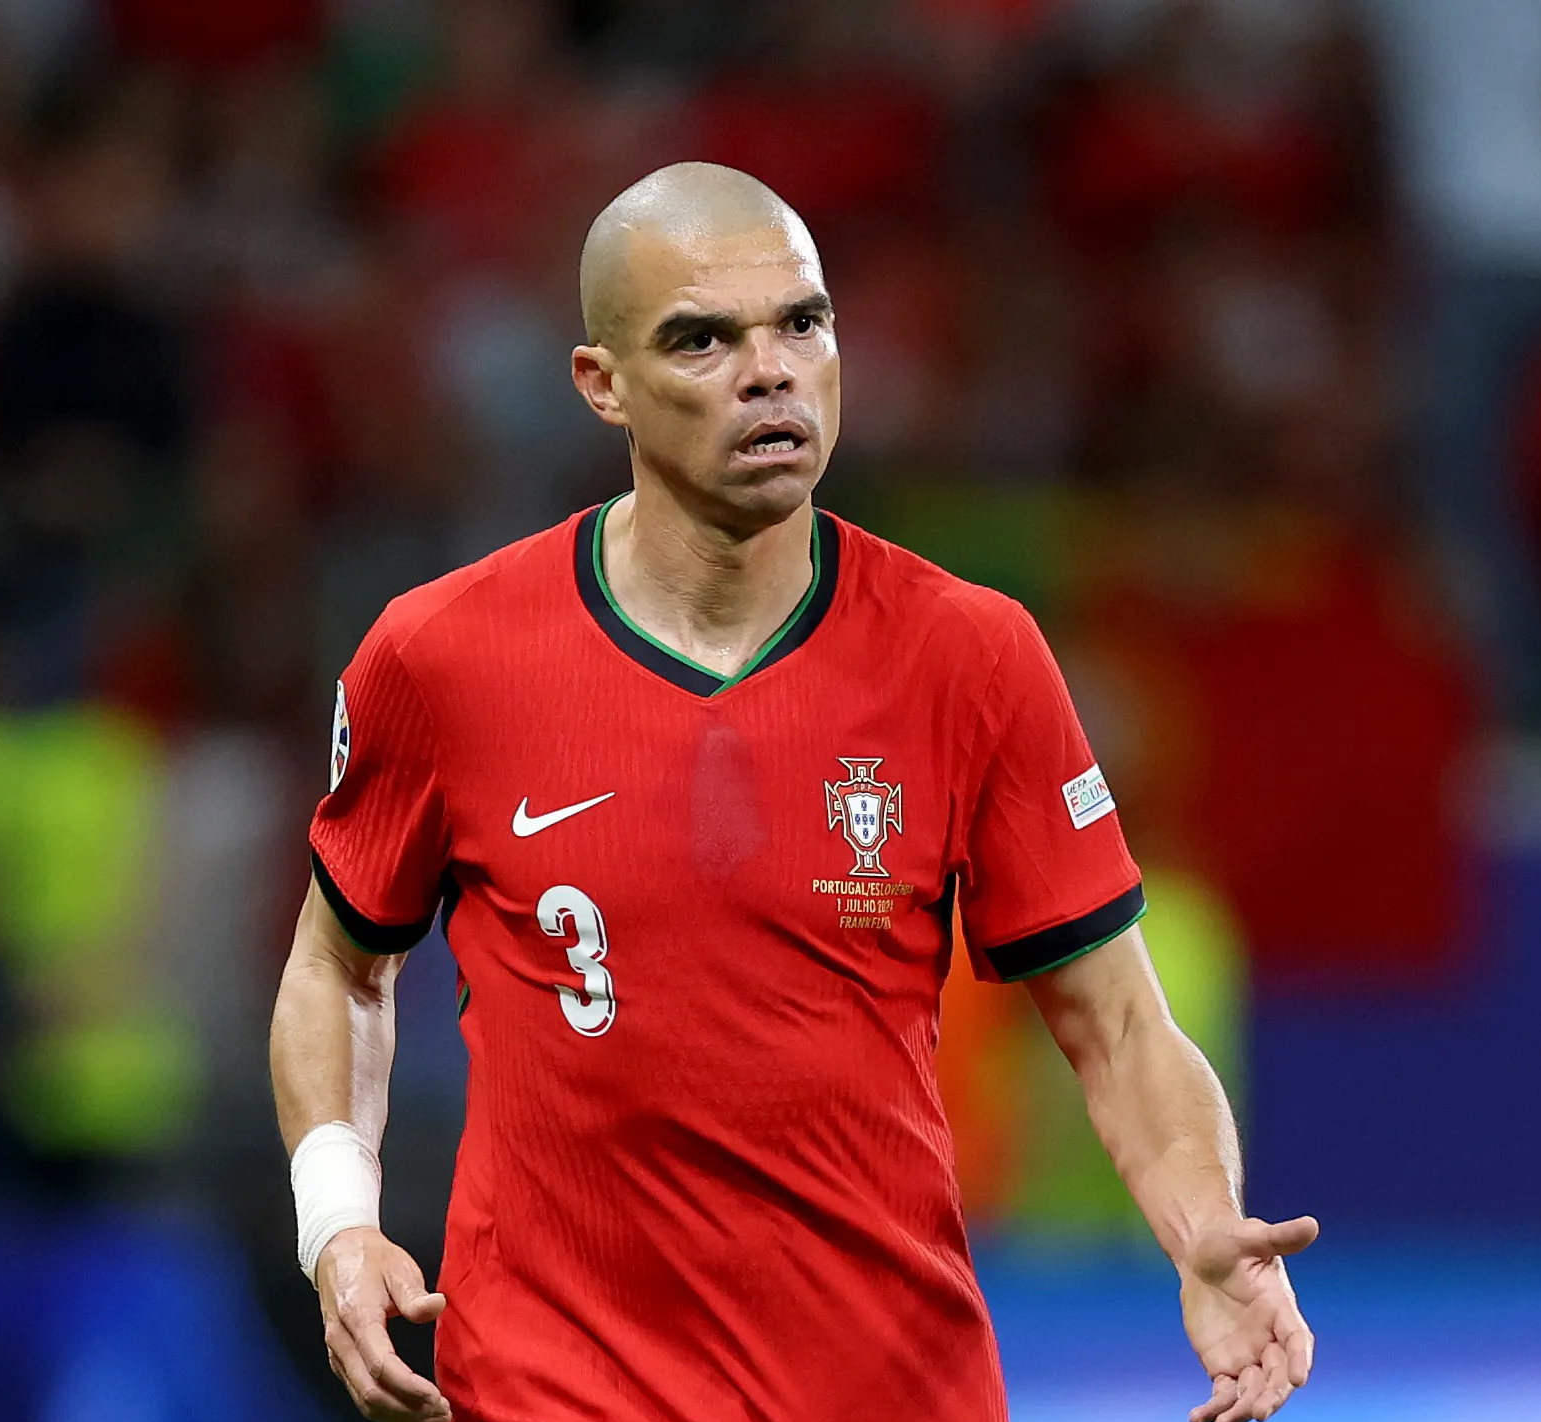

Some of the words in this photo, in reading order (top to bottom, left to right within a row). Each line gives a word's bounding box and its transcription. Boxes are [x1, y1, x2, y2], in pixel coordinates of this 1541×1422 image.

[1066, 778, 1088, 796] UEFA
[836, 898, 841, 912] 1
[844, 898, 876, 913] JULHO
[537, 885, 616, 1037] 3
